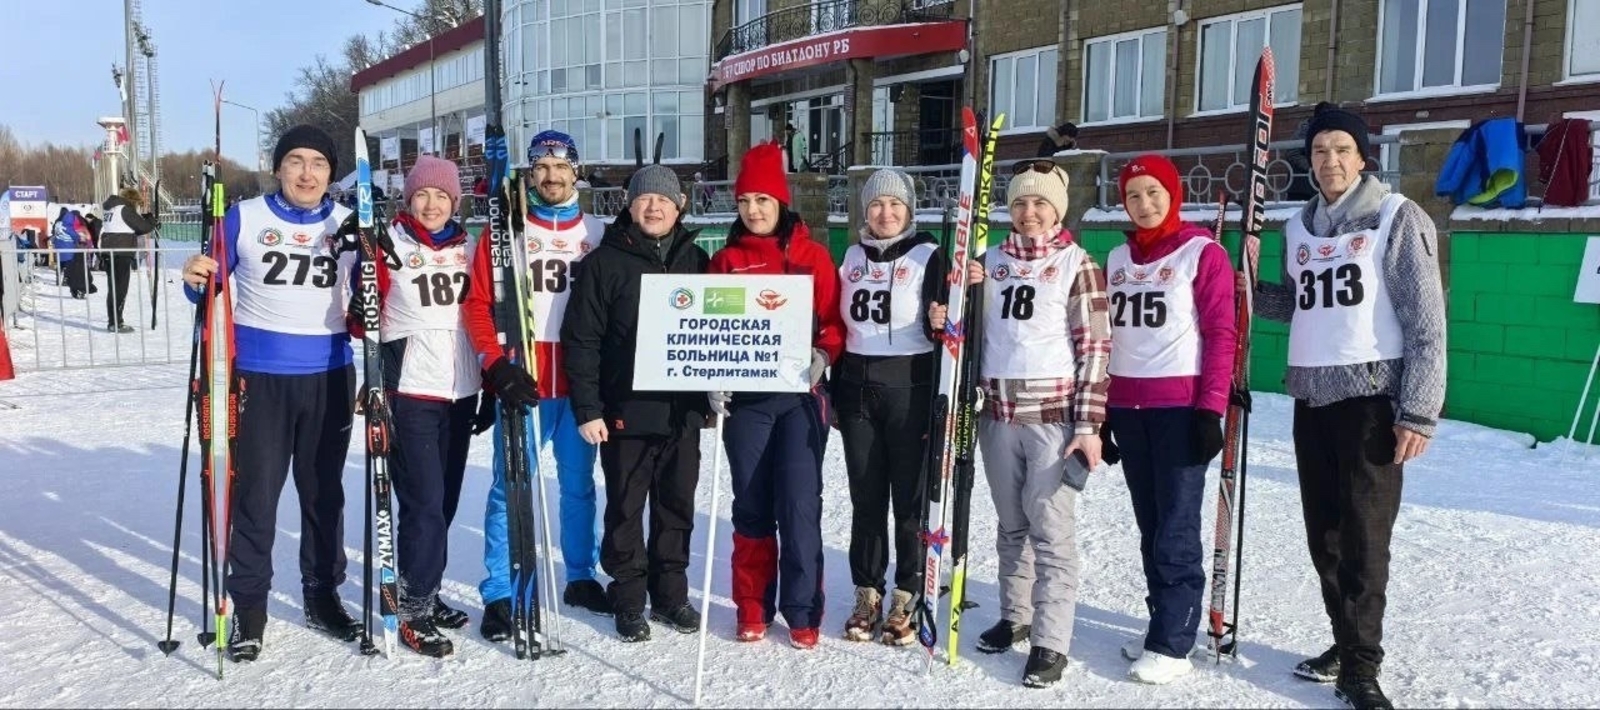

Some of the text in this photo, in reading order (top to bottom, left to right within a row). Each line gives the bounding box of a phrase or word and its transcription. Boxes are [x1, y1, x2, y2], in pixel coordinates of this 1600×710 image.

[757, 55, 770, 70] ПО
[771, 43, 830, 67] БИАТЛОНУ
[834, 38, 850, 54] РБ
[15, 190, 38, 198] СТАРТ
[951, 191, 971, 285] SABLE
[261, 251, 338, 288] 273
[1299, 263, 1364, 310] 313
[362, 263, 379, 331] ROSSIG
[411, 271, 471, 306] 182
[850, 289, 891, 324] 83
[1001, 284, 1035, 320] 18
[679, 318, 771, 332] ГОРОДСКАЯ
[1111, 291, 1167, 328] 215
[667, 334, 781, 346] КЛИНИЧЕСКАЯ
[667, 350, 779, 364] БОЛЬНИЦА №1
[667, 365, 778, 380] г. Стерлитамак
[203, 394, 211, 440] ROSSIGNOL
[376, 515, 394, 568] ZYMAX
[926, 557, 936, 596] TOUR
